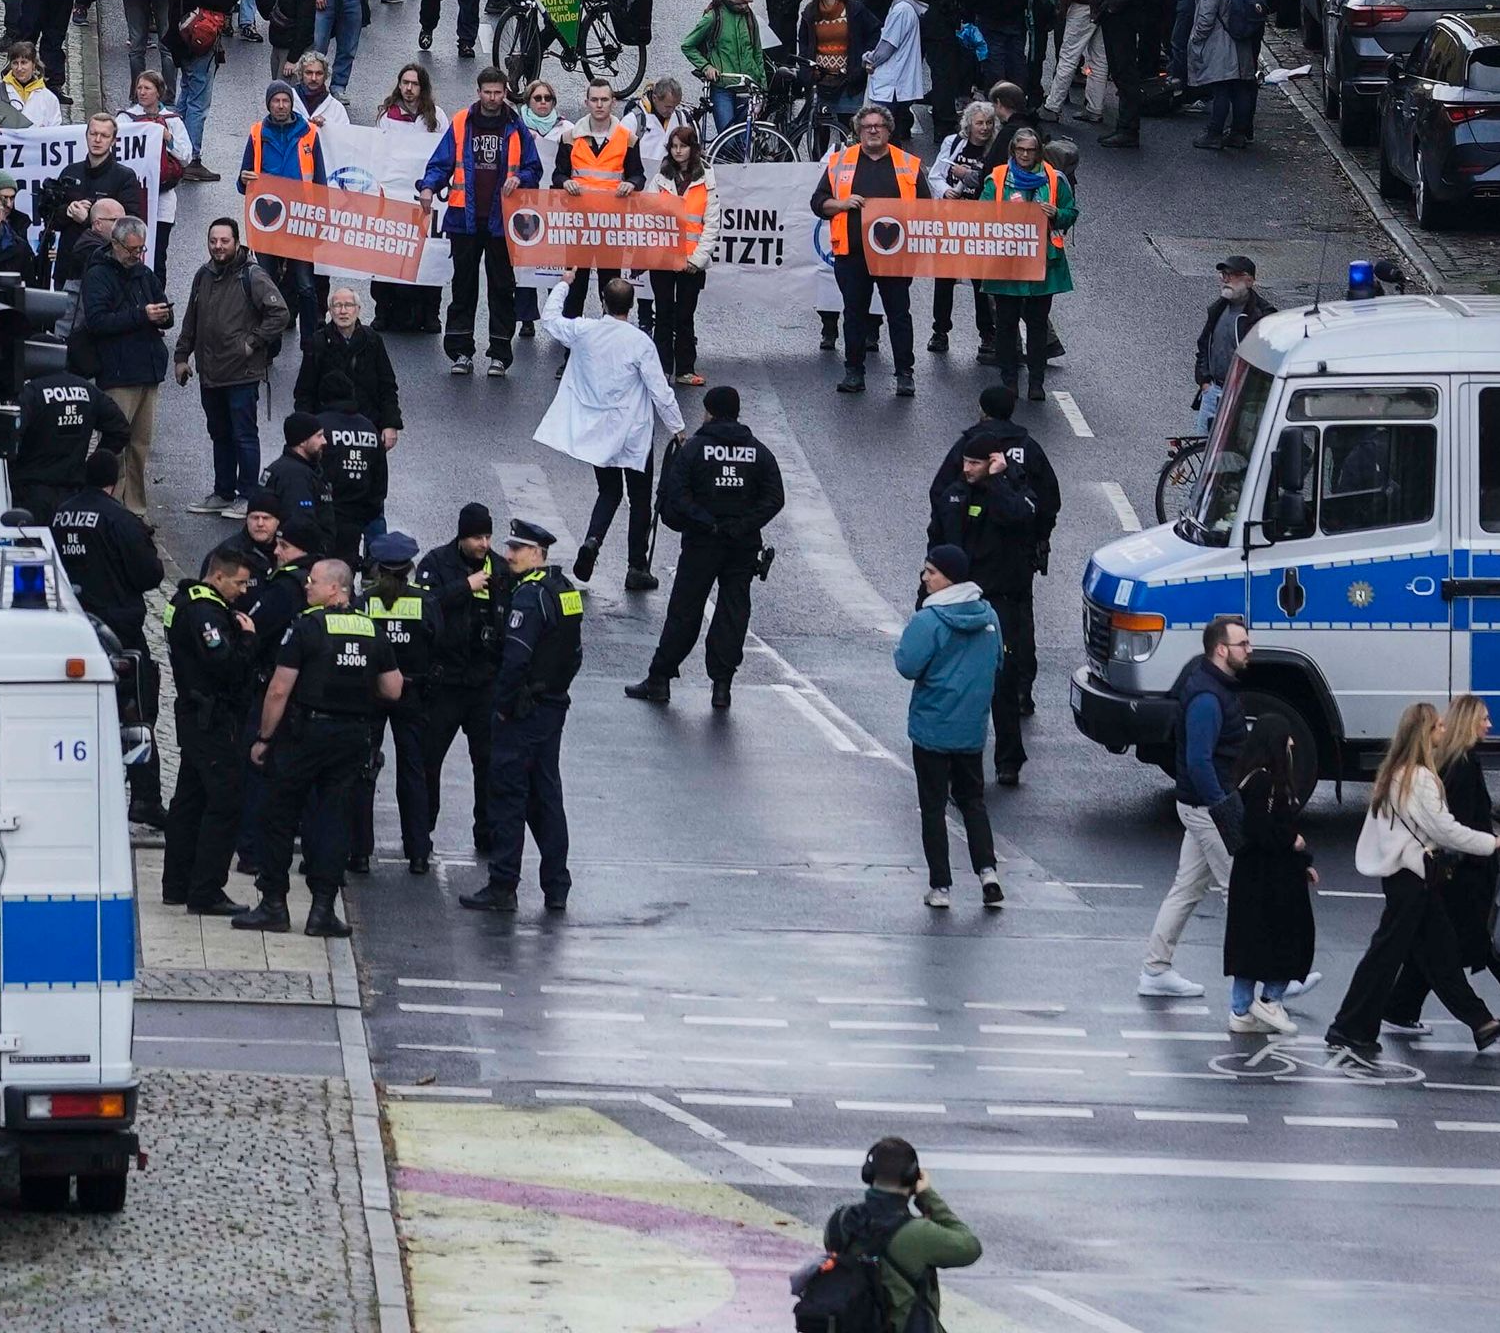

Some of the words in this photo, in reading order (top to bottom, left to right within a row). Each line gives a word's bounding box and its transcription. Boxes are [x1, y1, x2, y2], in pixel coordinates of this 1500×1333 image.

[550, 11, 579, 23] Kinder
[41, 140, 77, 166] IST
[289, 201, 325, 222] WEG
[329, 207, 363, 228] VON
[365, 214, 420, 241] FOSSIL
[547, 212, 584, 228] WEG
[587, 213, 622, 229] VON
[625, 213, 680, 231] FOSSIL
[719, 208, 784, 232] SINN.
[286, 217, 311, 238] HIN
[315, 223, 341, 244] ZU
[343, 229, 419, 259] GERECHT
[907, 221, 944, 237] WEG
[947, 221, 983, 237] VON
[984, 222, 1039, 239] FOSSIL
[547, 231, 577, 245] HIN
[581, 231, 601, 245] ZU
[605, 231, 679, 247] GERECHT
[907, 238, 937, 253] HIN
[940, 239, 962, 254] ZU
[964, 239, 1039, 256] GERECHT
[43, 387, 90, 404] POLIZEI
[65, 405, 77, 415] BE
[58, 415, 83, 426] 12226
[332, 430, 378, 448] POLIZEI
[349, 450, 362, 461] BE
[704, 446, 756, 463] POLIZEI
[722, 466, 736, 476] BE
[715, 477, 744, 487] 12223
[52, 512, 99, 528] POLIZEI
[67, 533, 79, 544] BE
[62, 544, 86, 555] 16004
[328, 615, 375, 635] POLIZEI
[387, 621, 402, 632] BE
[345, 643, 360, 654] BE
[336, 654, 367, 666] 35006
[53, 740, 88, 762] 16
